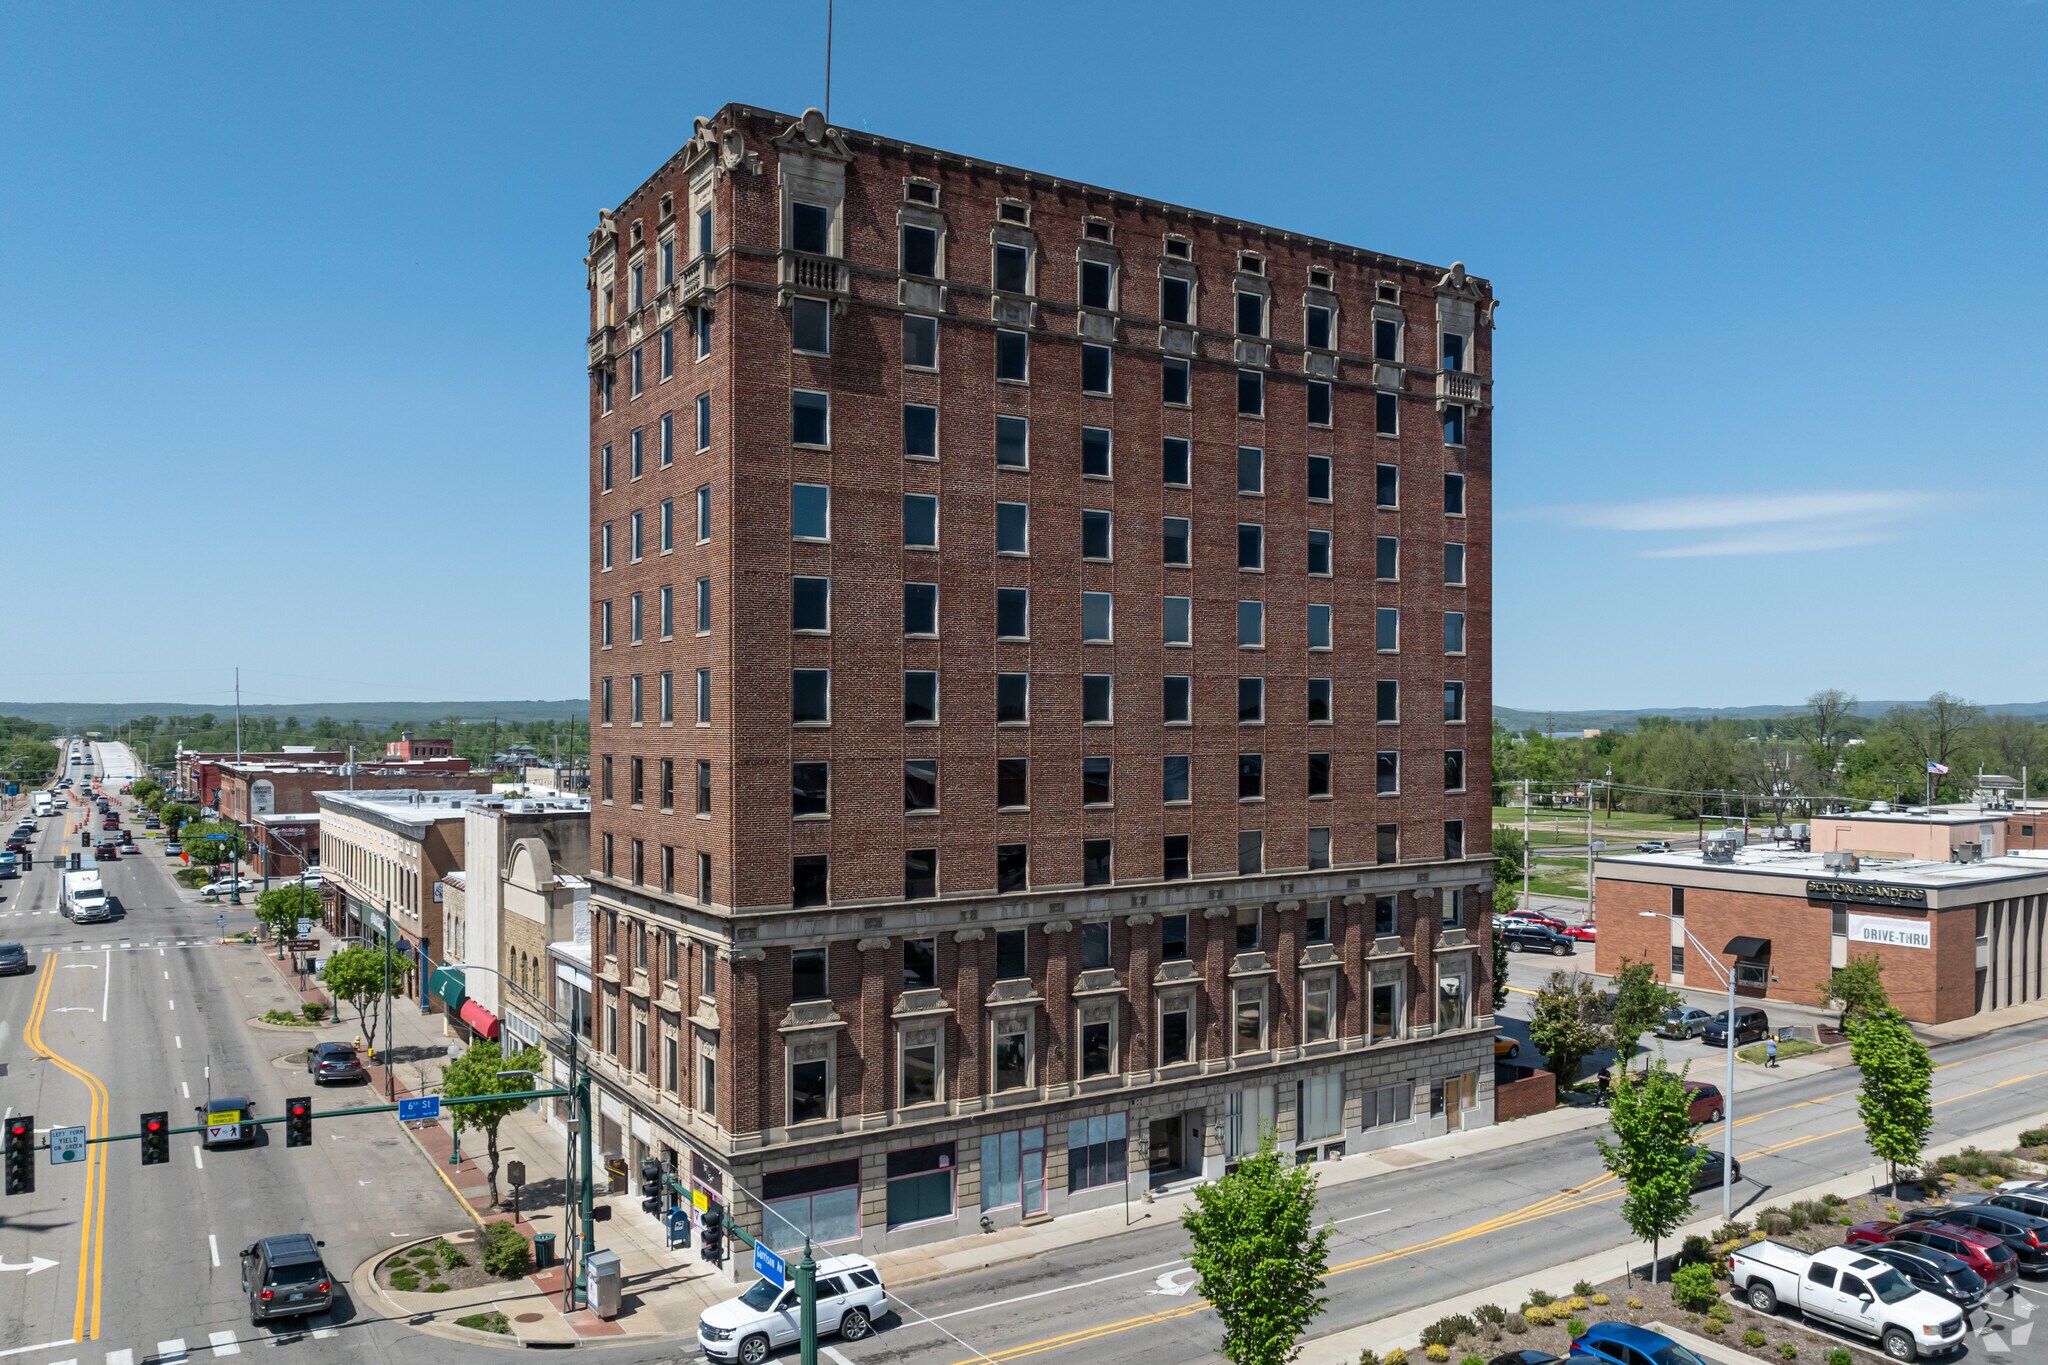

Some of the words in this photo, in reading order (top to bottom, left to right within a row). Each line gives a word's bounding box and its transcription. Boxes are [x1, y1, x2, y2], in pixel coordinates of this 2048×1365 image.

[1808, 881, 1853, 896] SEXTON
[1855, 885, 1864, 895] &
[1866, 886, 1924, 900] SANDERS
[1863, 927, 1929, 946] DRIVE-THRU
[422, 1100, 431, 1109] St
[59, 1136, 78, 1144] YIELD
[756, 1246, 775, 1269] Garrison
